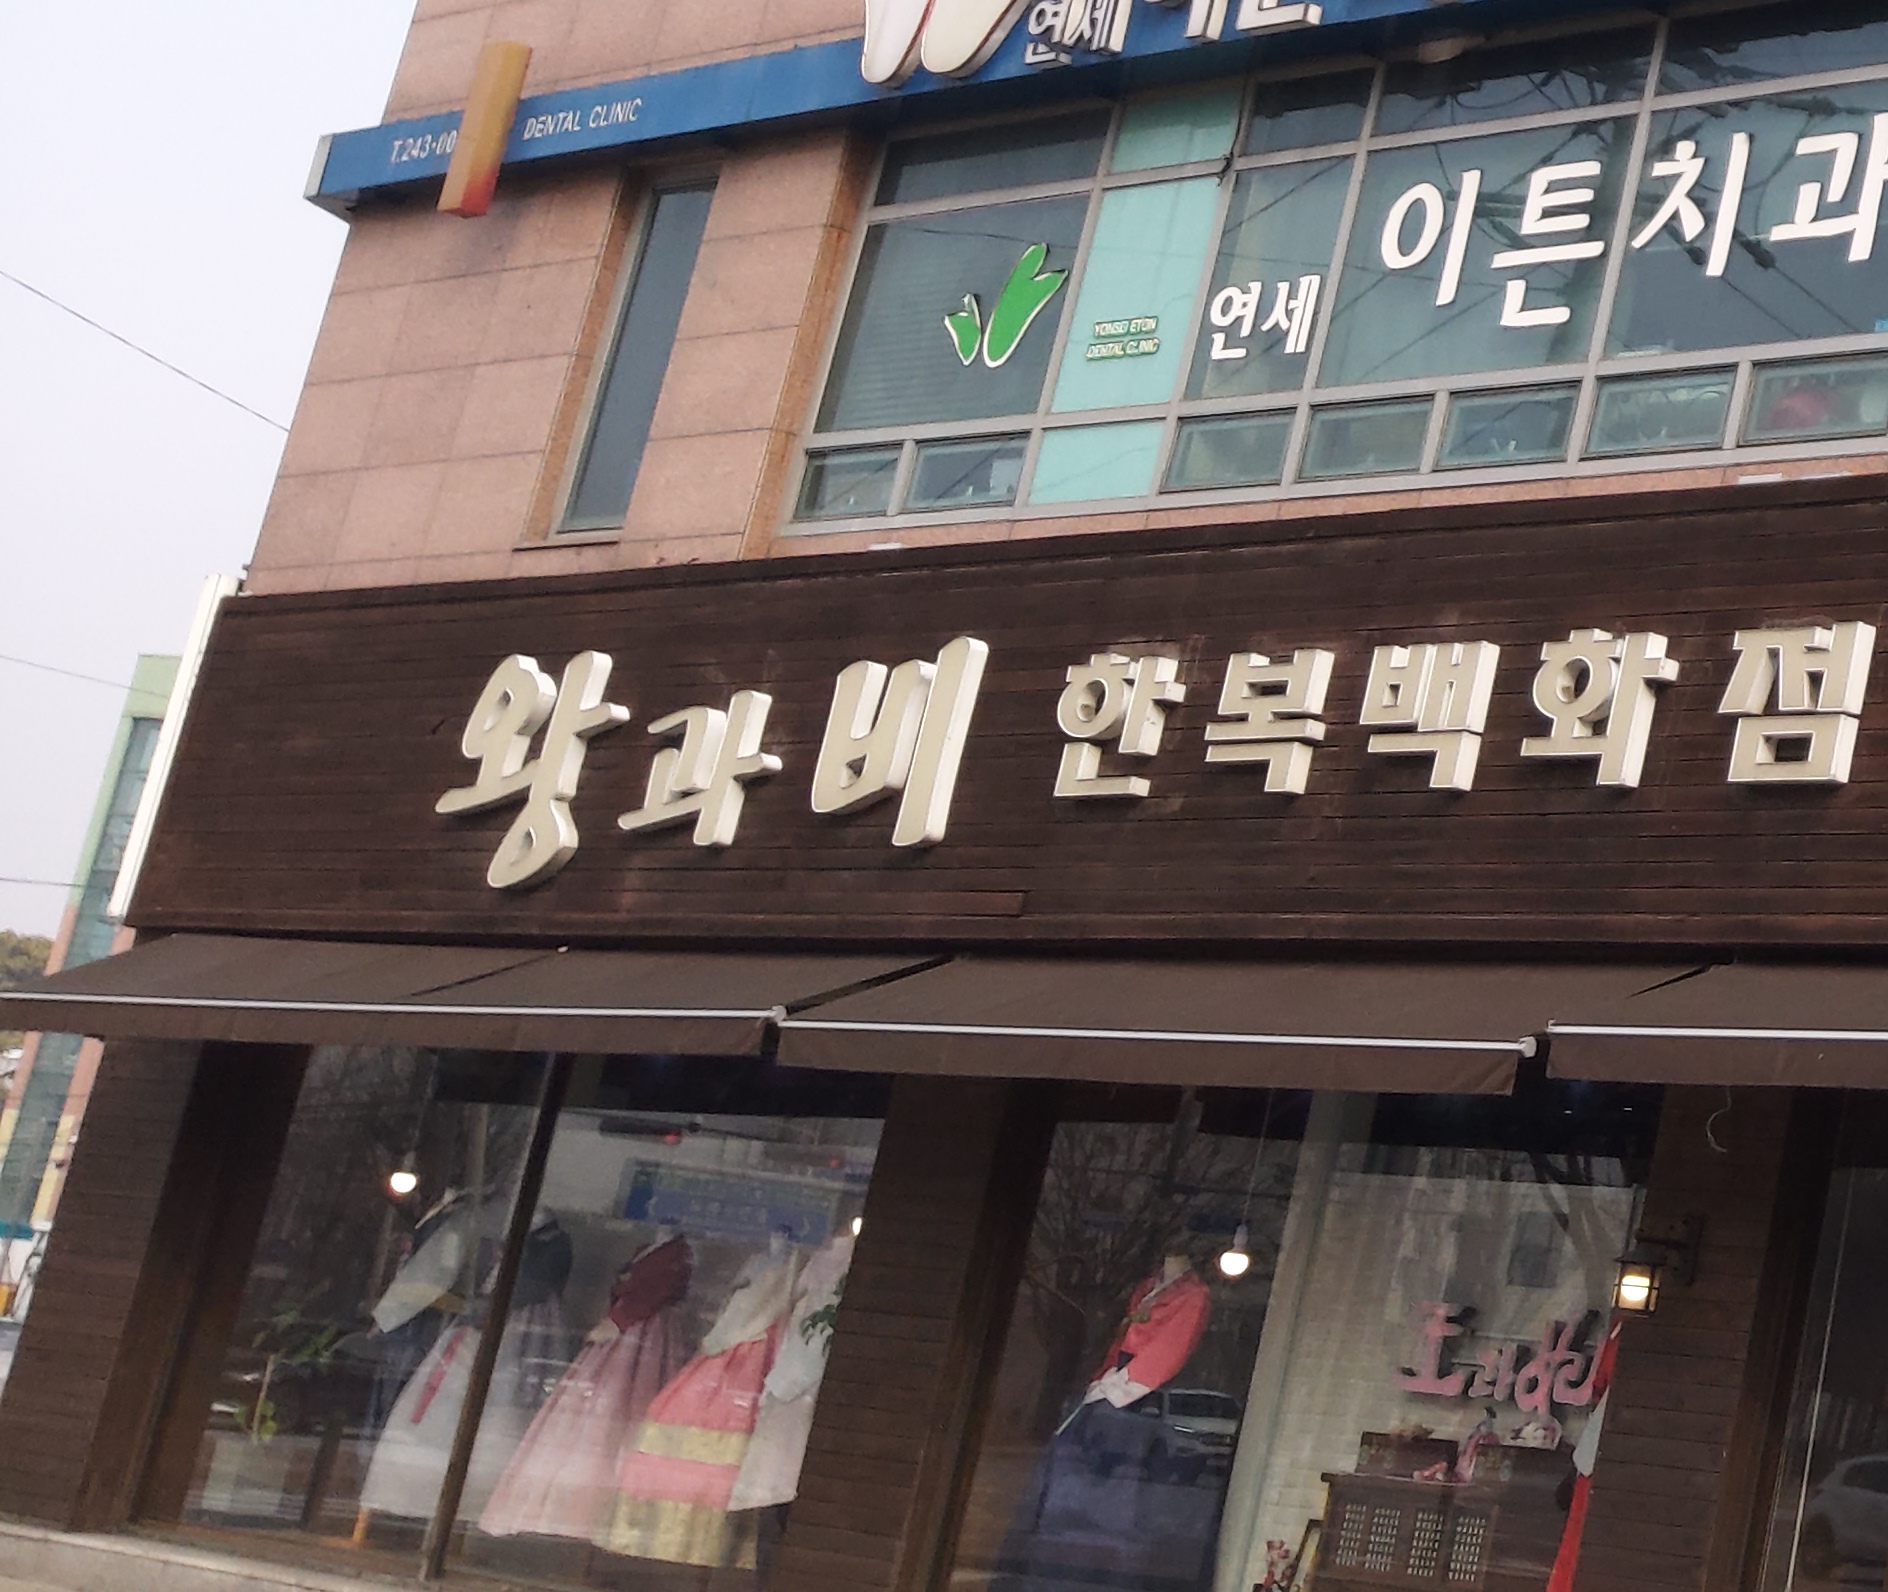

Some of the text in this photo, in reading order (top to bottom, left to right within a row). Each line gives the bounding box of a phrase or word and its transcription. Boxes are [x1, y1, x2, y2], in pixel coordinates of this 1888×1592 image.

[522, 110, 582, 141] DENTAL
[588, 97, 642, 129] CLINIC
[1208, 273, 1322, 361] 연세
[434, 618, 1877, 890] 왕과비 한복백화점
